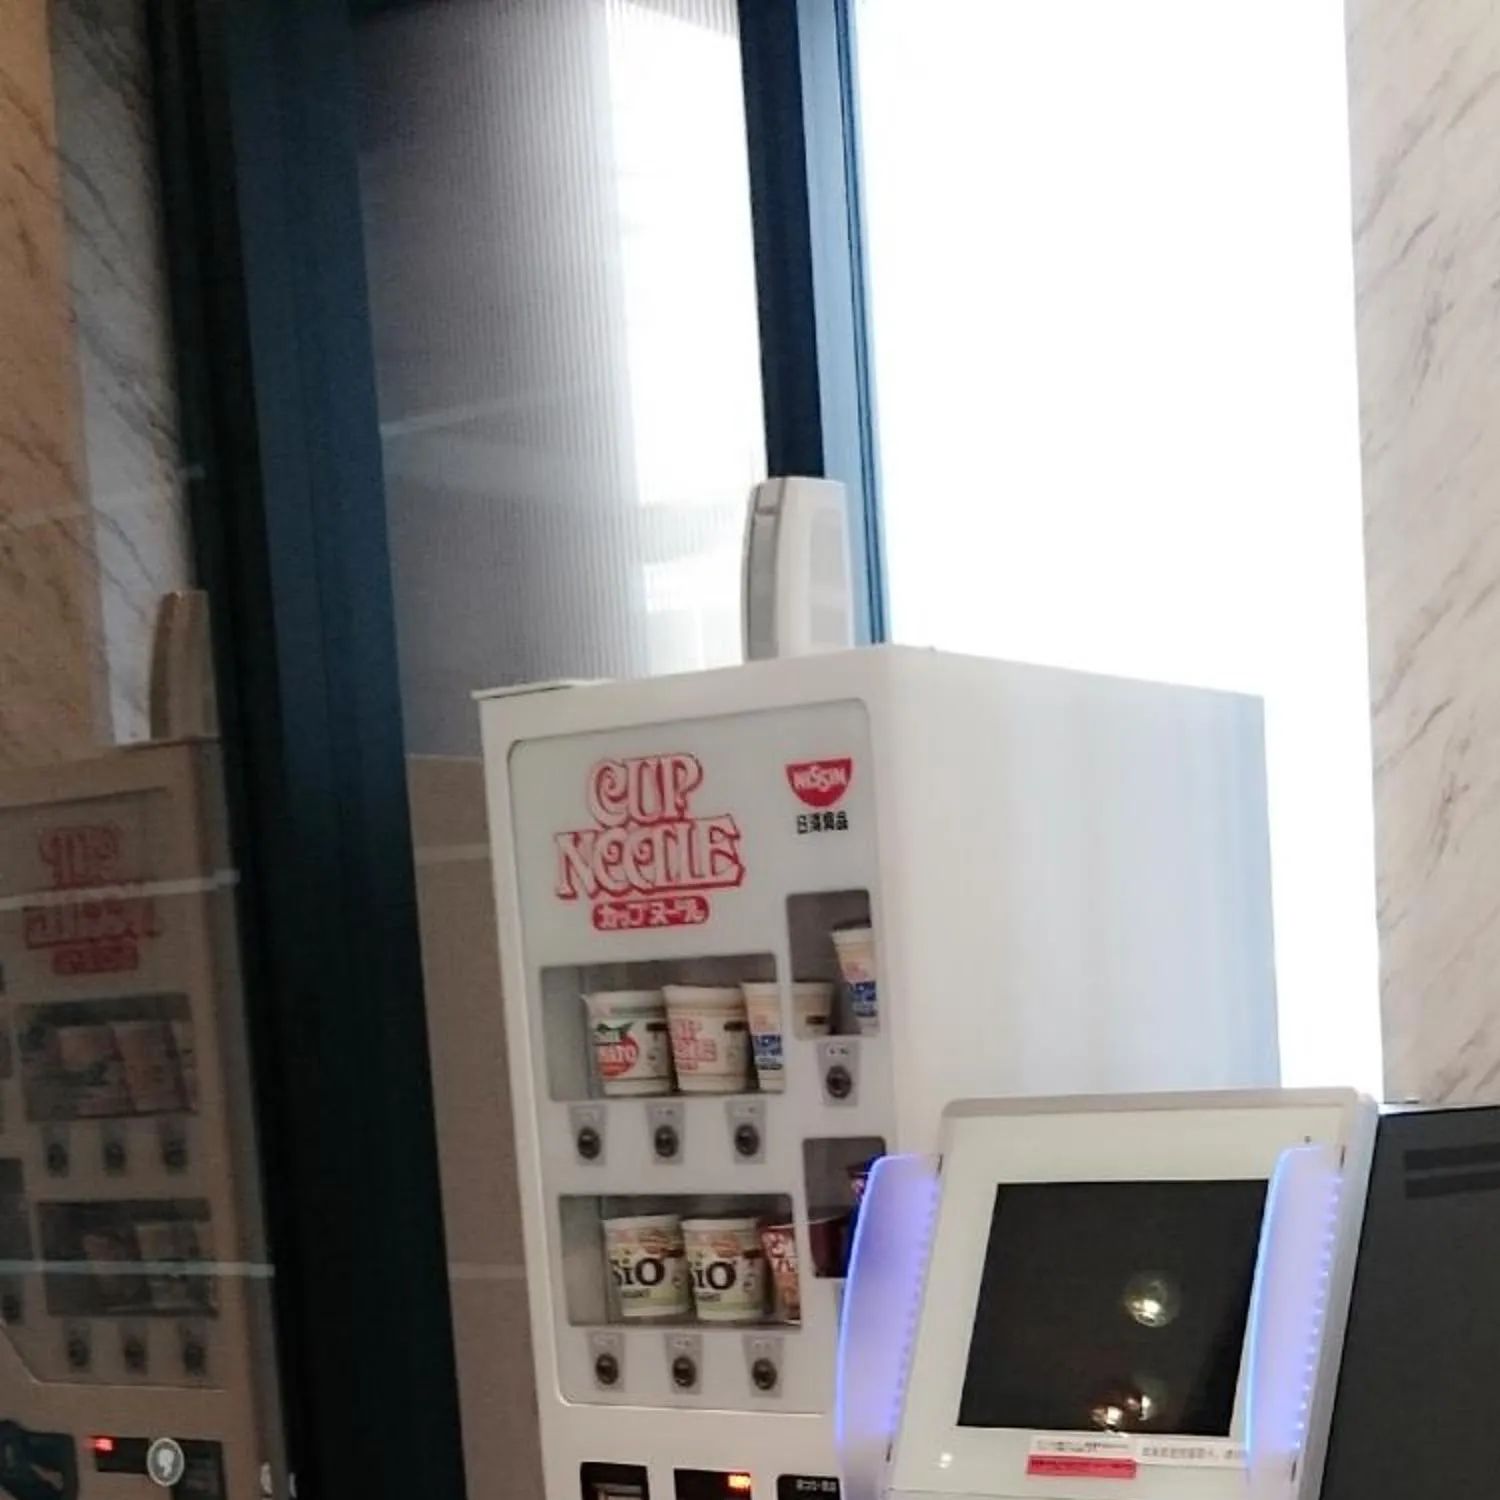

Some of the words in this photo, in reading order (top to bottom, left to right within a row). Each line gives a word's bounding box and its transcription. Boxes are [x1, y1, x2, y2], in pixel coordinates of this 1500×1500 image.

[588, 752, 703, 829] CUP
[793, 765, 847, 792] NISSIN
[796, 811, 849, 834] 日清食品
[553, 813, 746, 901] NOODLE
